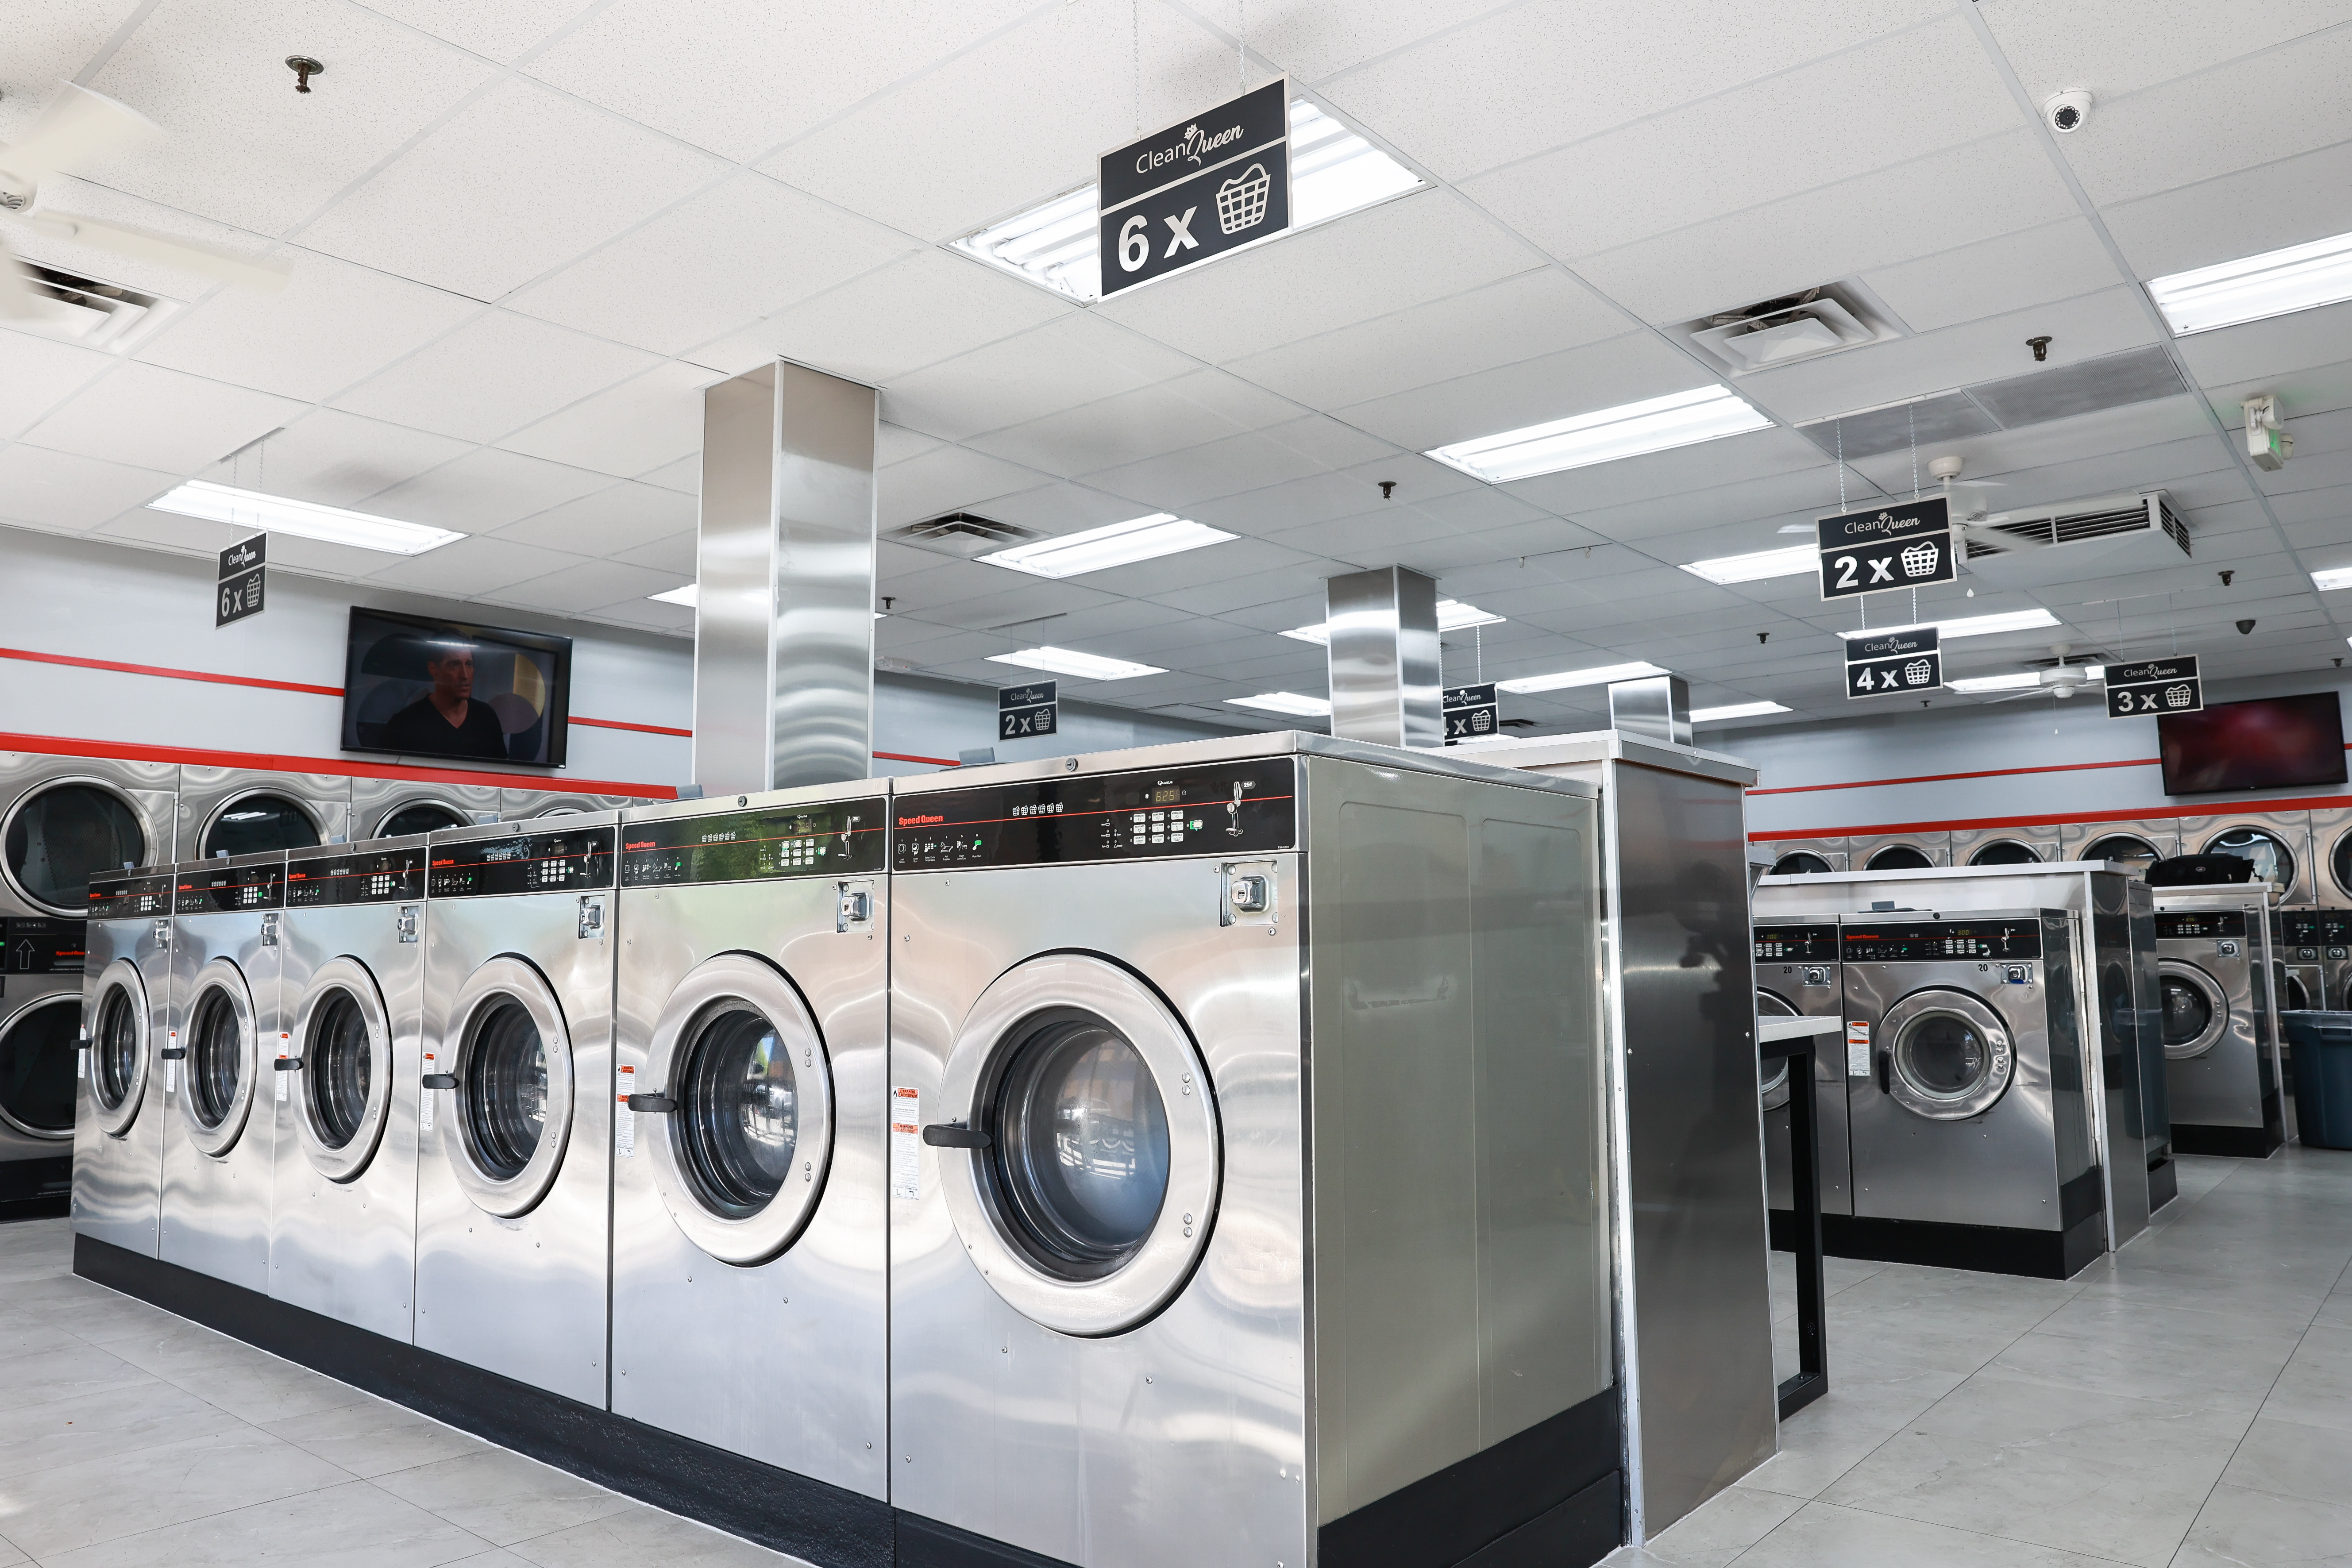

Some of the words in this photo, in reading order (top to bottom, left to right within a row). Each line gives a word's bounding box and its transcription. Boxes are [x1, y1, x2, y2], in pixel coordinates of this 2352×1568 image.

[1118, 215, 1149, 272] 6
[1163, 206, 1199, 259] x
[1834, 555, 1859, 589] 2
[1867, 557, 1894, 584] x
[221, 587, 230, 617] 6
[232, 589, 243, 613] x
[1856, 667, 1874, 690] 4
[1880, 670, 1899, 689] x
[2117, 691, 2134, 712] 3
[2140, 693, 2159, 710] x
[1005, 714, 1015, 735] 2
[1020, 717, 1031, 733] x
[1454, 719, 1467, 735] x
[1156, 790, 1174, 802] 625
[898, 816, 920, 827] Speed
[921, 815, 943, 823] Queen
[625, 842, 640, 850] Speed
[1978, 963, 1988, 972] 20
